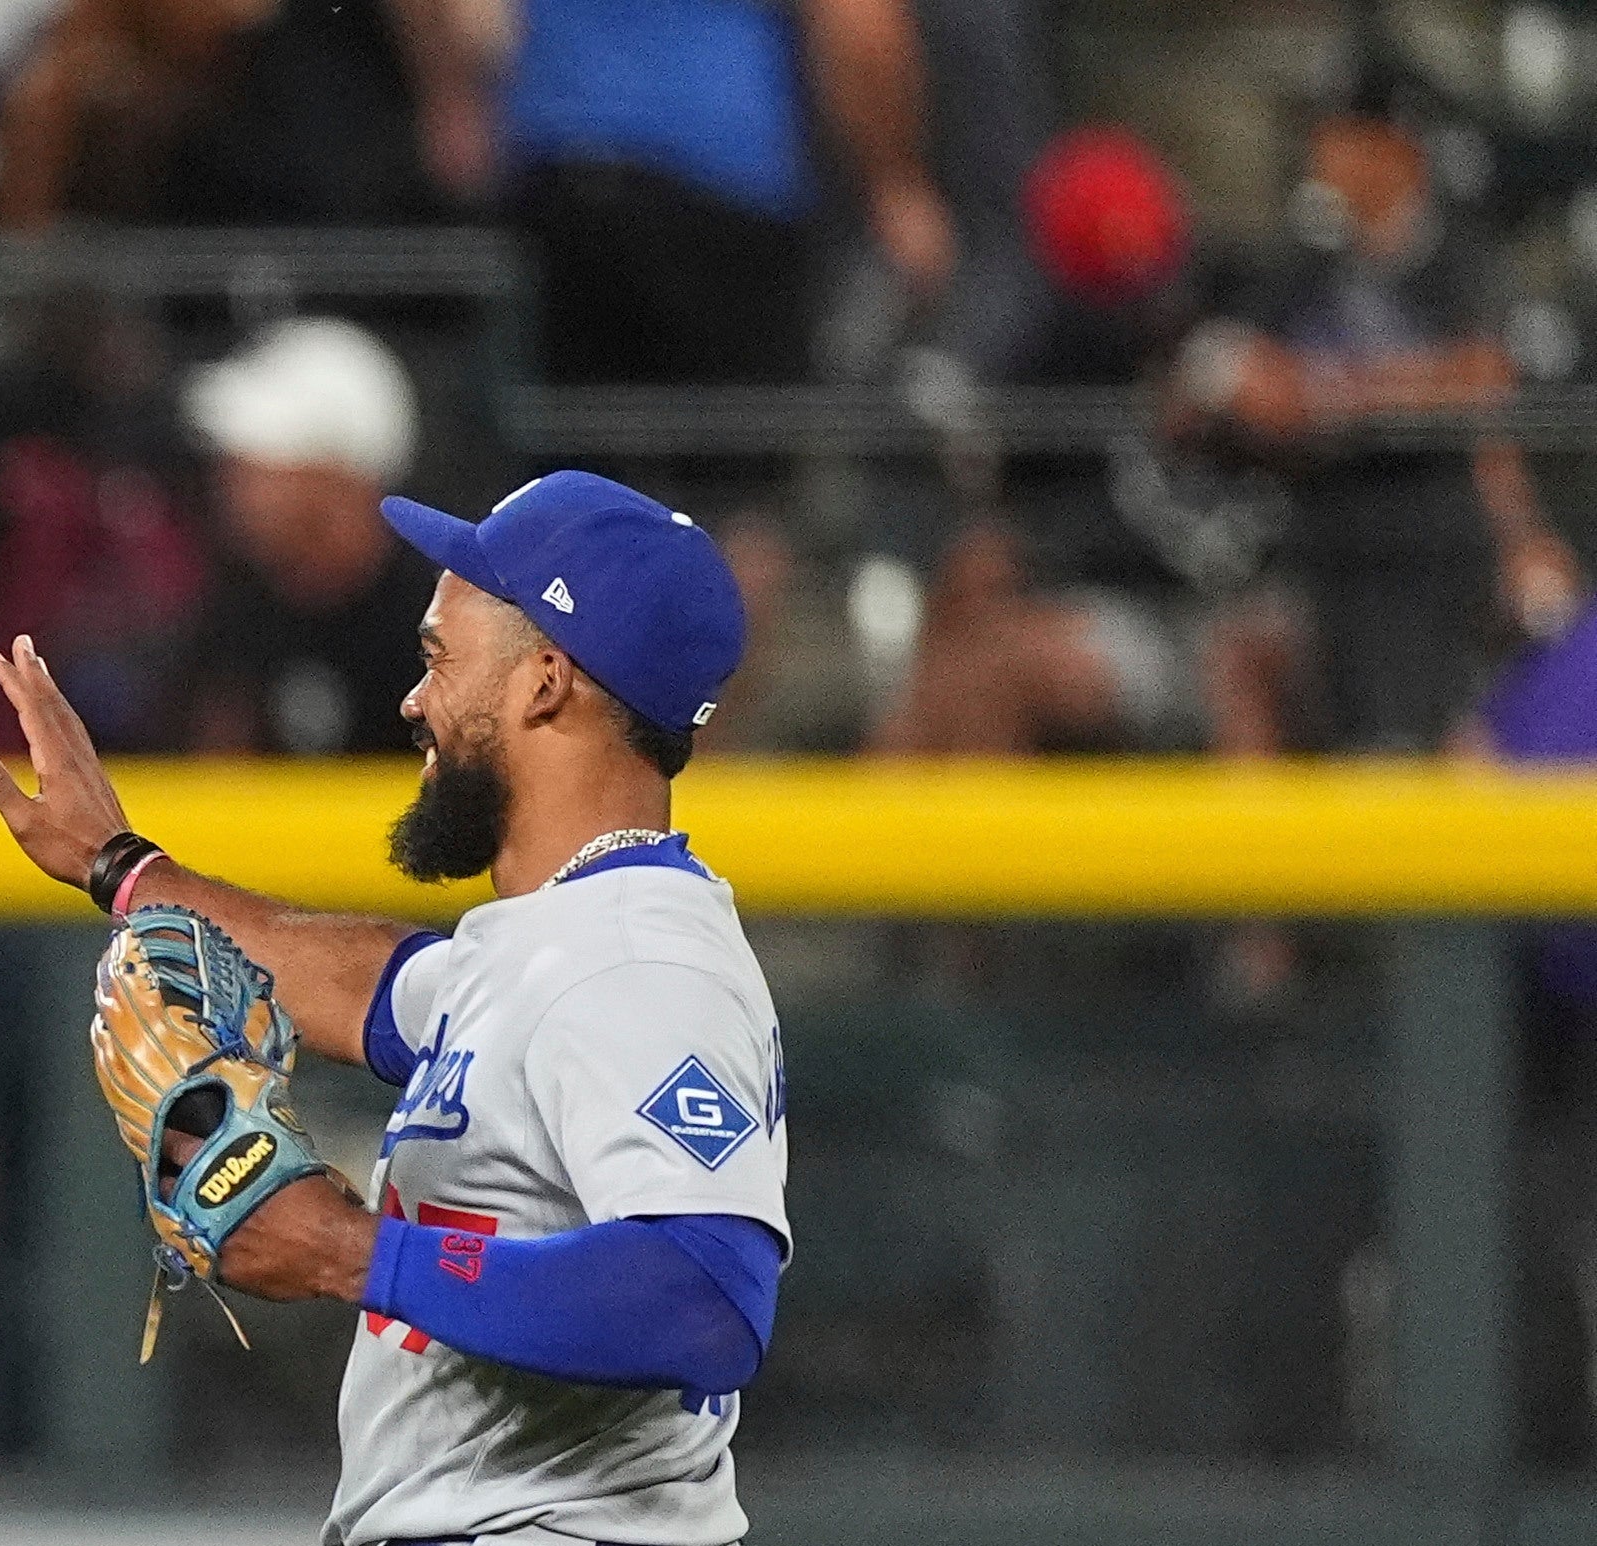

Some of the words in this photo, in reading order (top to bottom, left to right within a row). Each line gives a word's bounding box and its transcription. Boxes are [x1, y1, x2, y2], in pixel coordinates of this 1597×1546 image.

[676, 1087, 723, 1127] G
[199, 1137, 274, 1204] Wilson
[438, 1234, 486, 1284] 37
